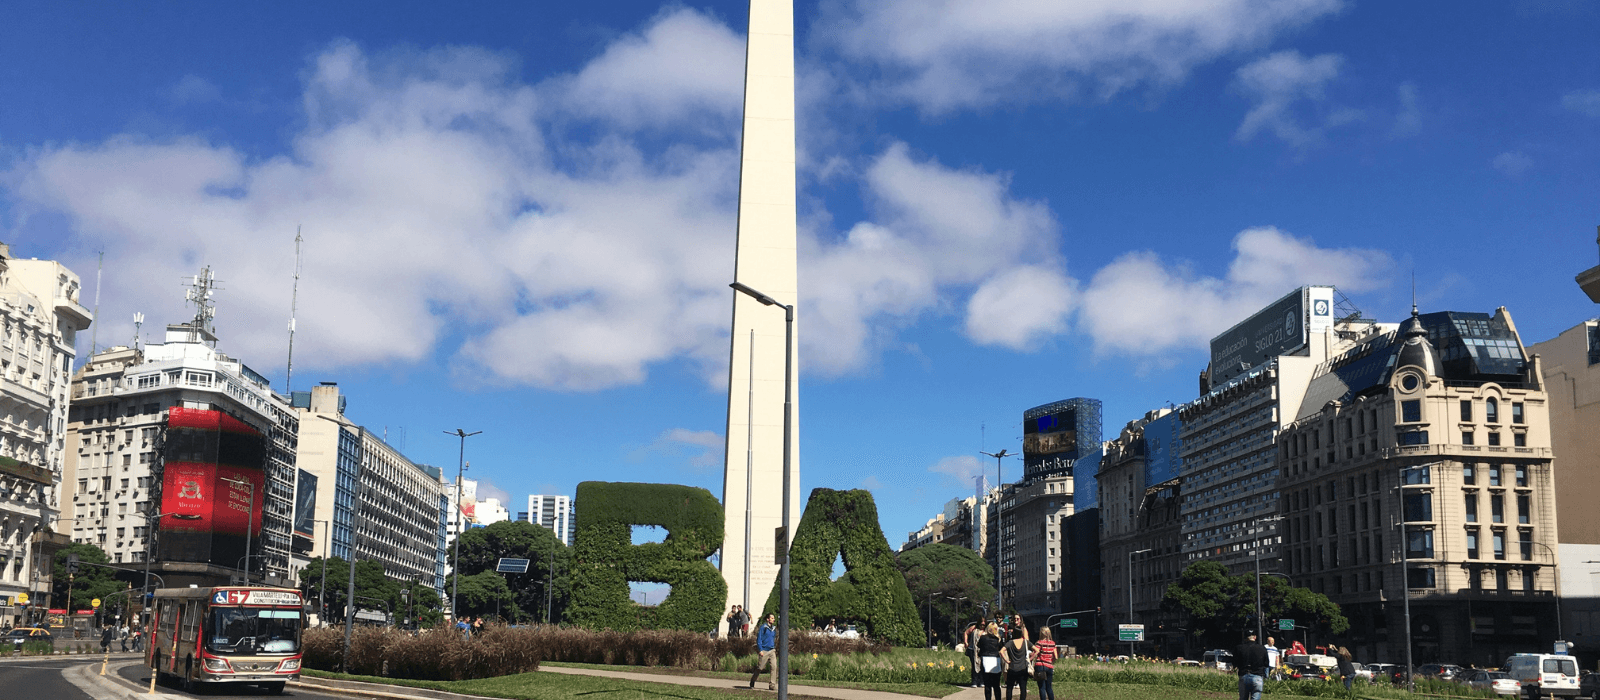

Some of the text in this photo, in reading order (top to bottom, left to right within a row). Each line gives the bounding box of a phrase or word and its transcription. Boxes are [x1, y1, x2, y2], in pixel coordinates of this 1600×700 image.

[1255, 327, 1283, 353] SIGLO 21
[228, 591, 250, 604] 67
